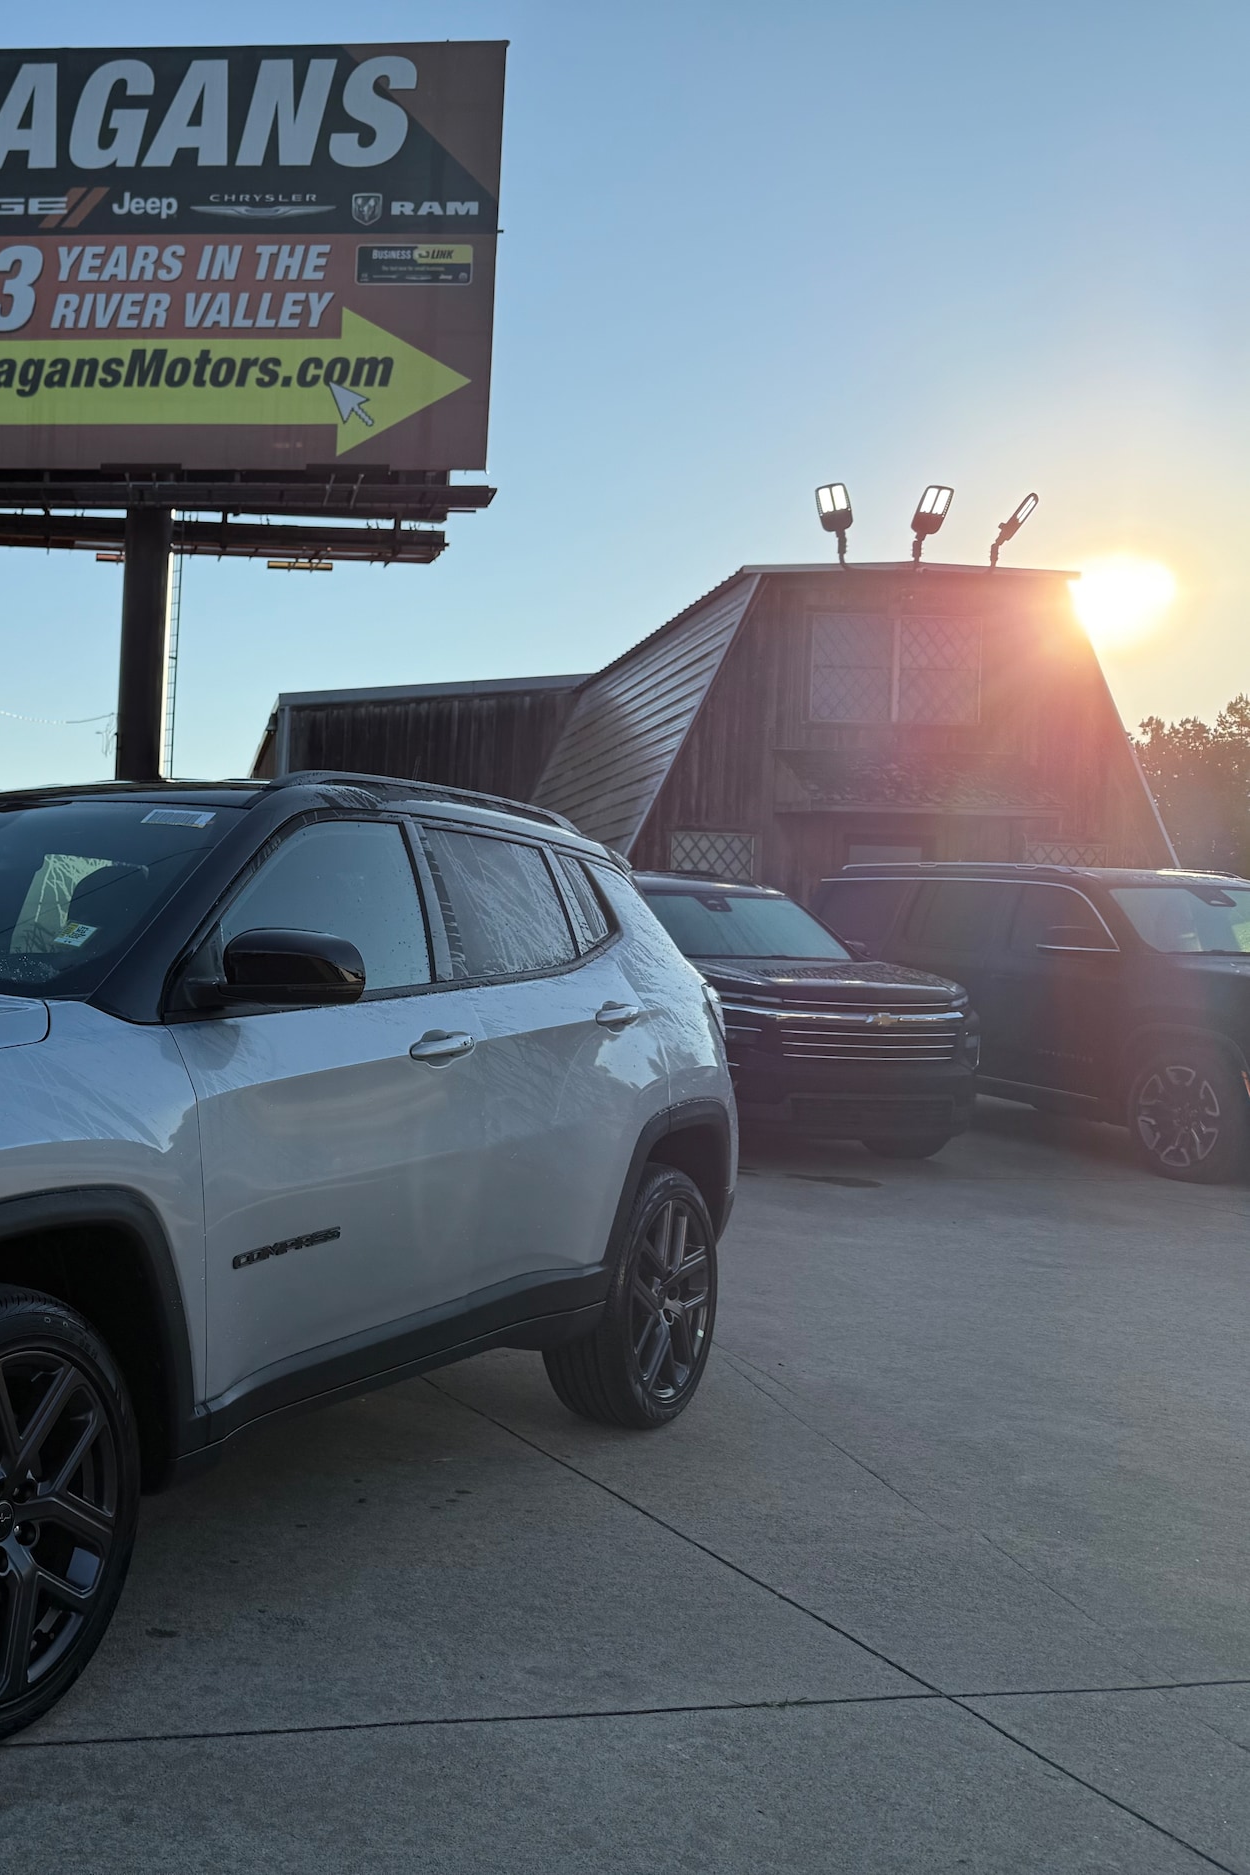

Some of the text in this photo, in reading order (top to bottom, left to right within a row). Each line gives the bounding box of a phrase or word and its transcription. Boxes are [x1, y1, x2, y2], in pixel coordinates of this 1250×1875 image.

[112, 191, 178, 219] Jeep
[209, 193, 317, 202] CHRYSLER
[390, 201, 479, 216] RAM
[57, 244, 332, 282] YEARS IN THE
[372, 249, 455, 260] BUSINESS LINK
[50, 292, 335, 329] RIVER VALLEY
[232, 1226, 341, 1269] COMPASS
